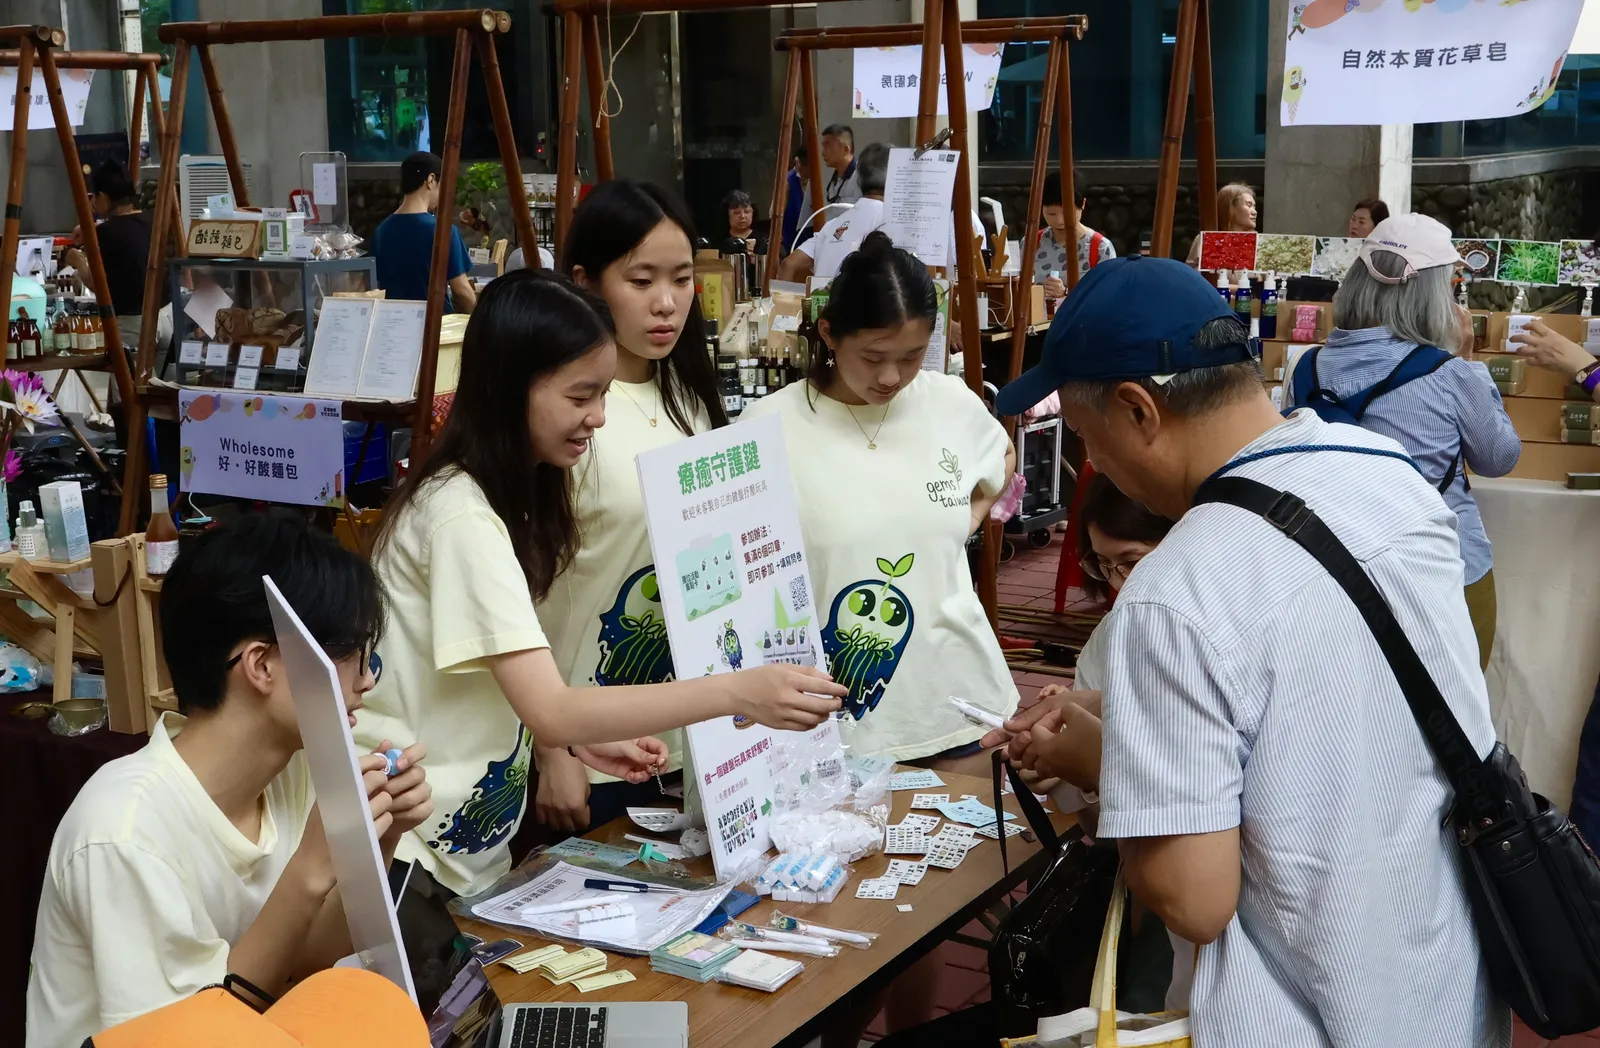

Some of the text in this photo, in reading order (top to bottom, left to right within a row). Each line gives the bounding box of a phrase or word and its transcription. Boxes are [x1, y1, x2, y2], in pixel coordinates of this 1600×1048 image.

[1342, 41, 1507, 69] 自然本質花草皂
[219, 437, 295, 459] Wholesome
[677, 440, 761, 495] 療癒守護鍵
[926, 480, 956, 502] gems
[939, 494, 969, 507] taiwa
